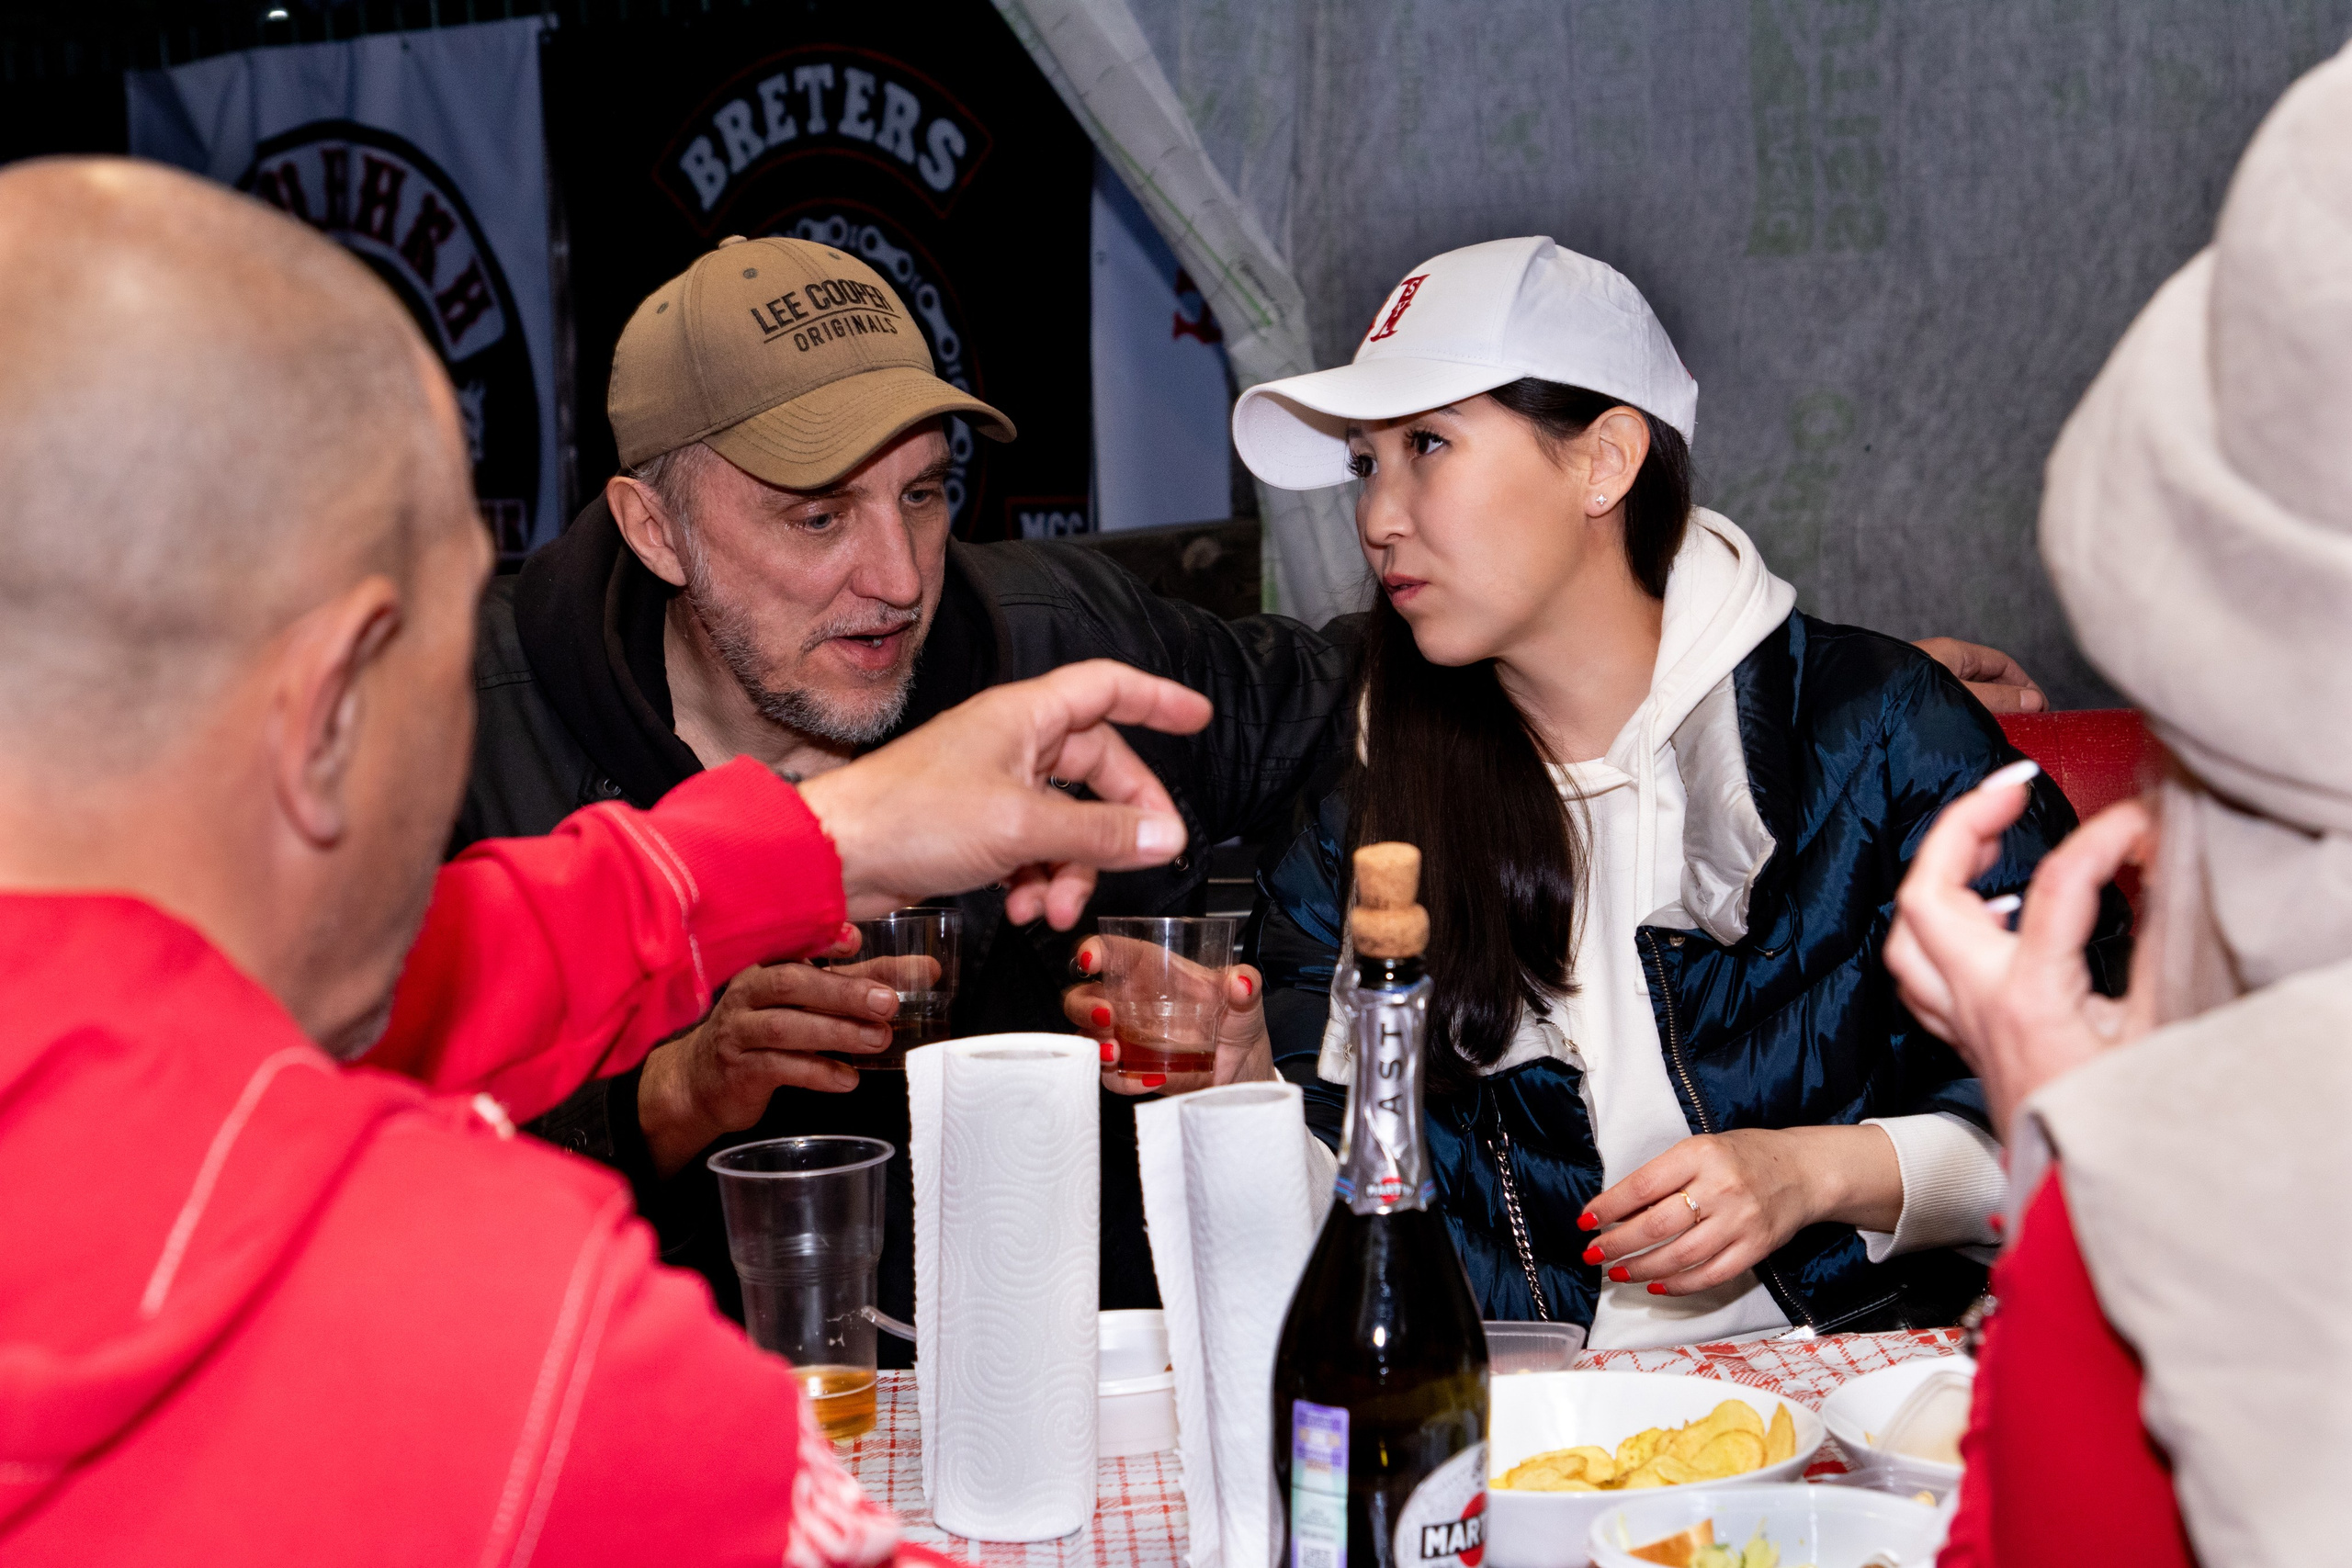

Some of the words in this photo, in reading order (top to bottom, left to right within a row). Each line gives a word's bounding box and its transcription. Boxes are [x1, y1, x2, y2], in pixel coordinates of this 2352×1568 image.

[678, 63, 967, 211] BRETERS
[751, 290, 810, 335] LEE
[804, 278, 895, 313] COOPER
[793, 313, 899, 352] ORIGINALS
